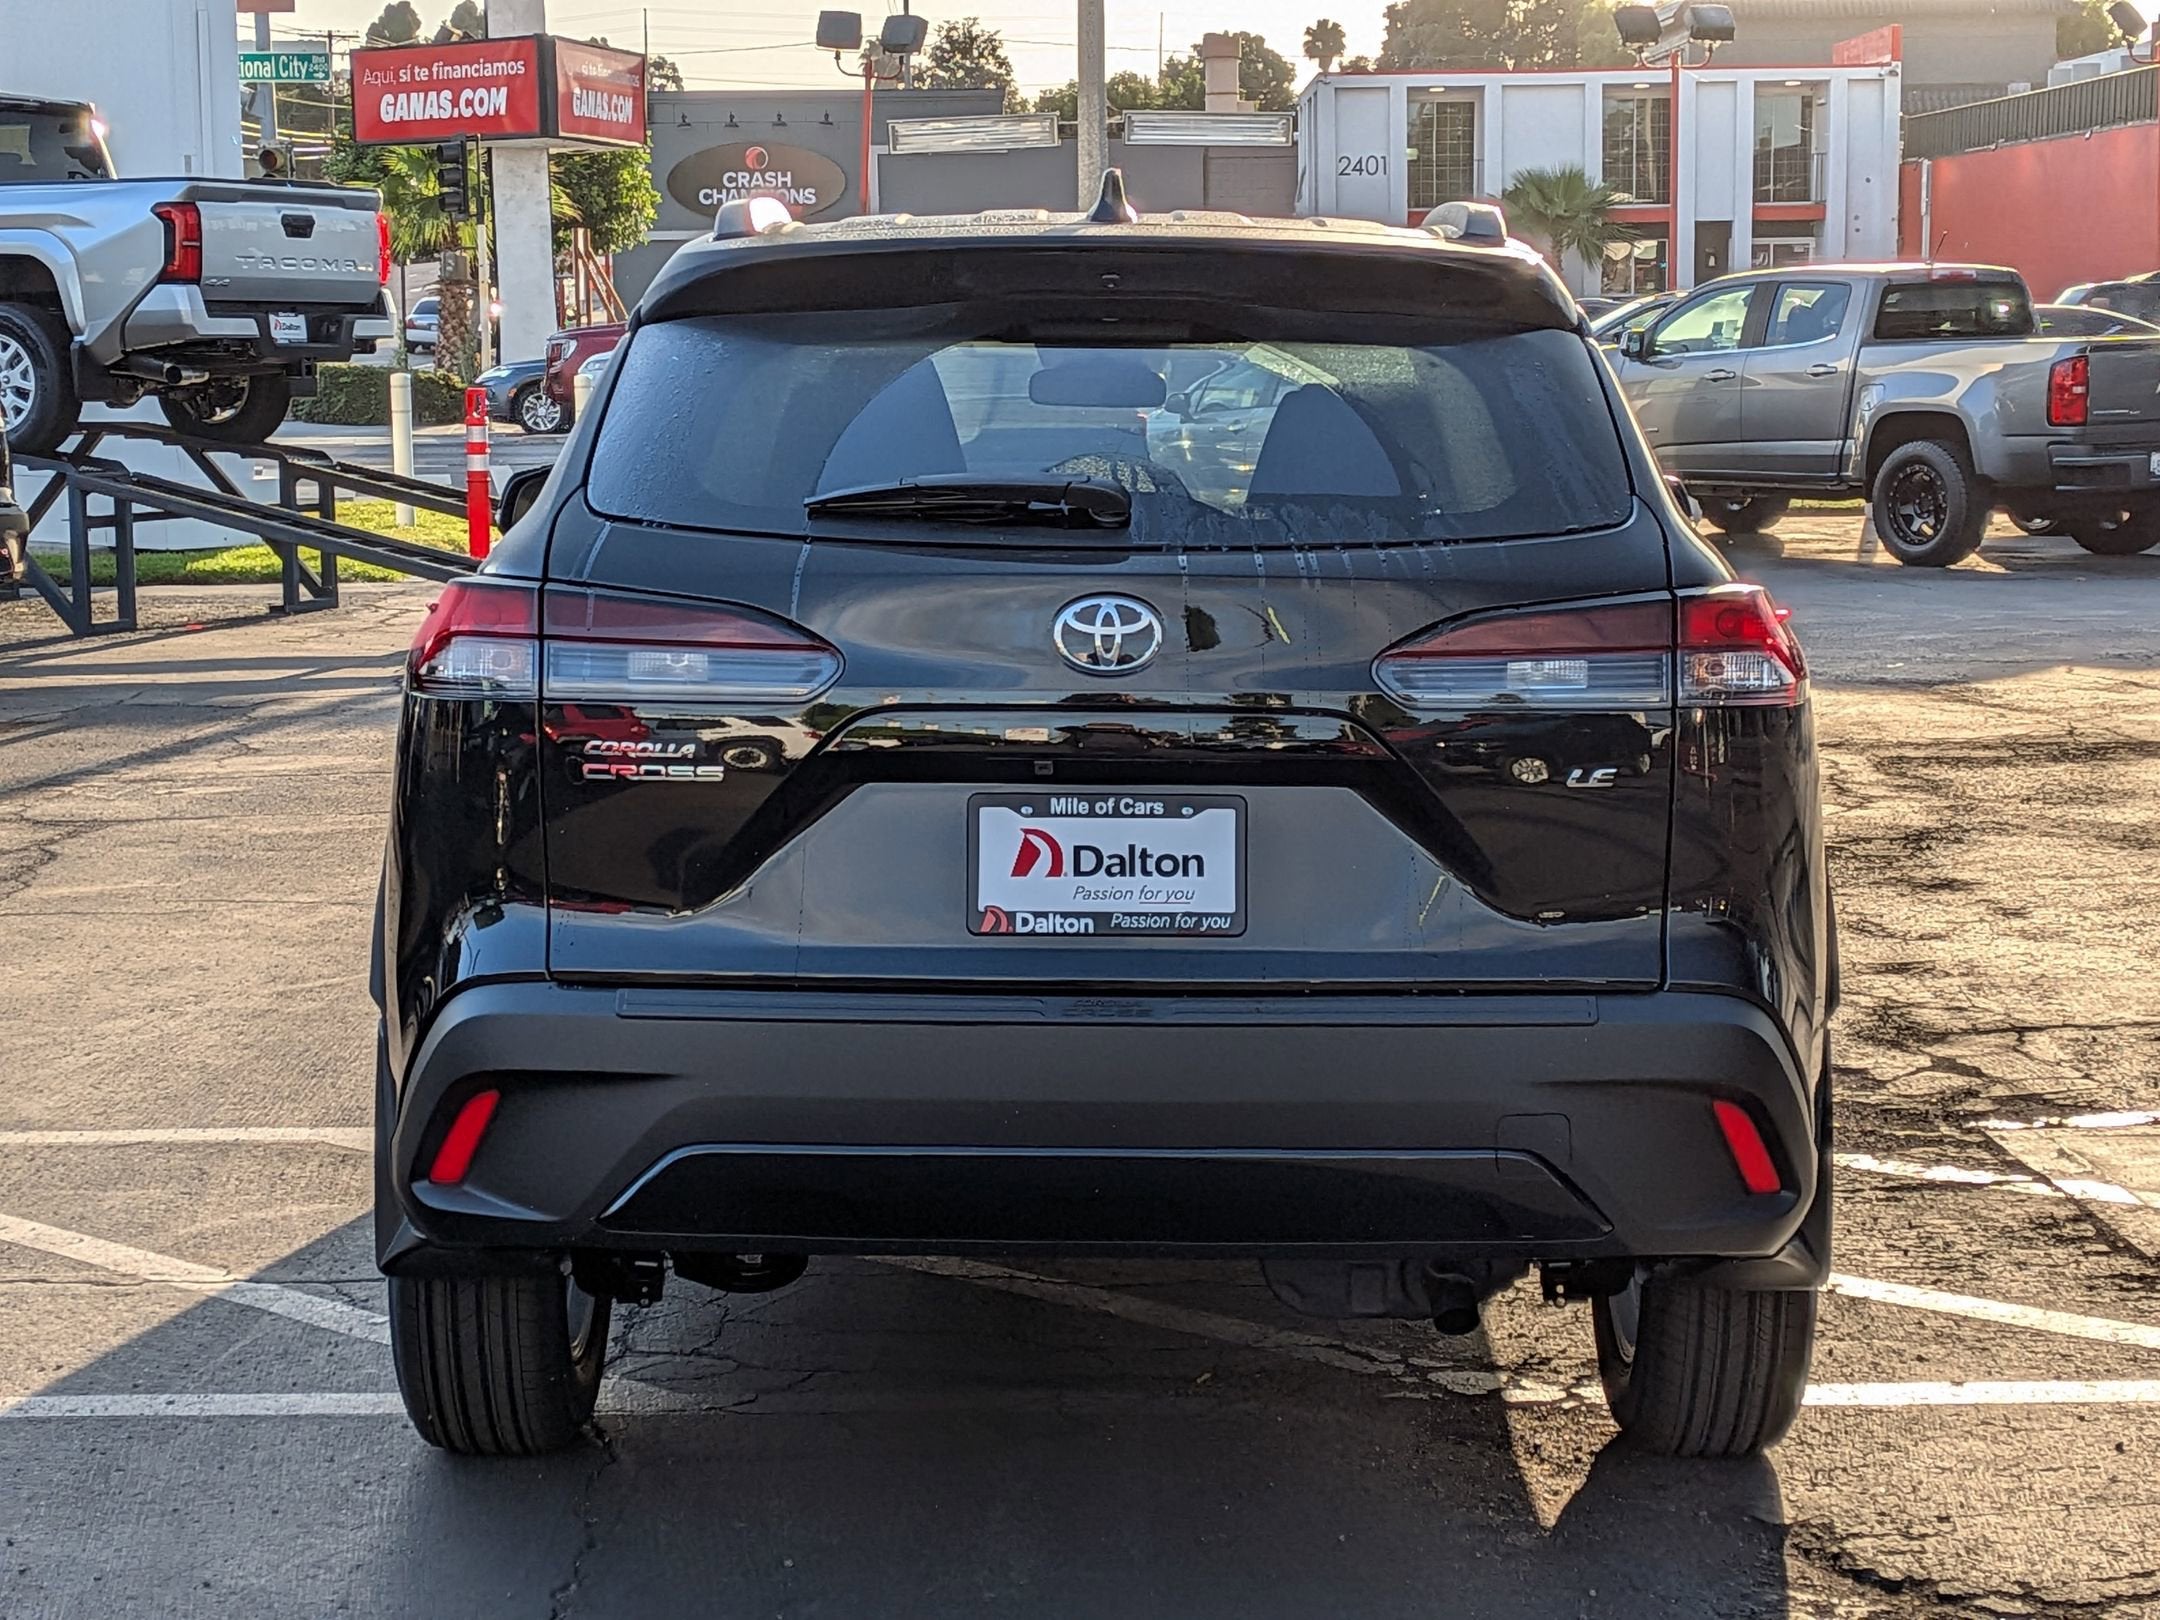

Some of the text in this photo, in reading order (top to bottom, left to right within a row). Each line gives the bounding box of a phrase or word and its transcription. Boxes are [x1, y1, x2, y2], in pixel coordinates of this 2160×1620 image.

[280, 55, 308, 79] City
[399, 64, 411, 82] sí
[414, 65, 429, 81] te
[431, 58, 525, 80] financiamos
[380, 86, 508, 123] GANAS.COM
[572, 87, 633, 124] GANAS.COM
[1338, 155, 1387, 176] 2401
[722, 171, 792, 188] CRASH
[235, 255, 357, 272] TACOMA
[583, 739, 696, 759] COROLLA
[582, 763, 725, 782] CROSS
[1566, 768, 1618, 788] LE
[1050, 797, 1165, 815] Mile of Cars
[1073, 844, 1205, 878] Dalton
[1073, 885, 1196, 904] Passion for you
[1015, 912, 1095, 934] Dalton
[1110, 913, 1231, 932] Passion for you
